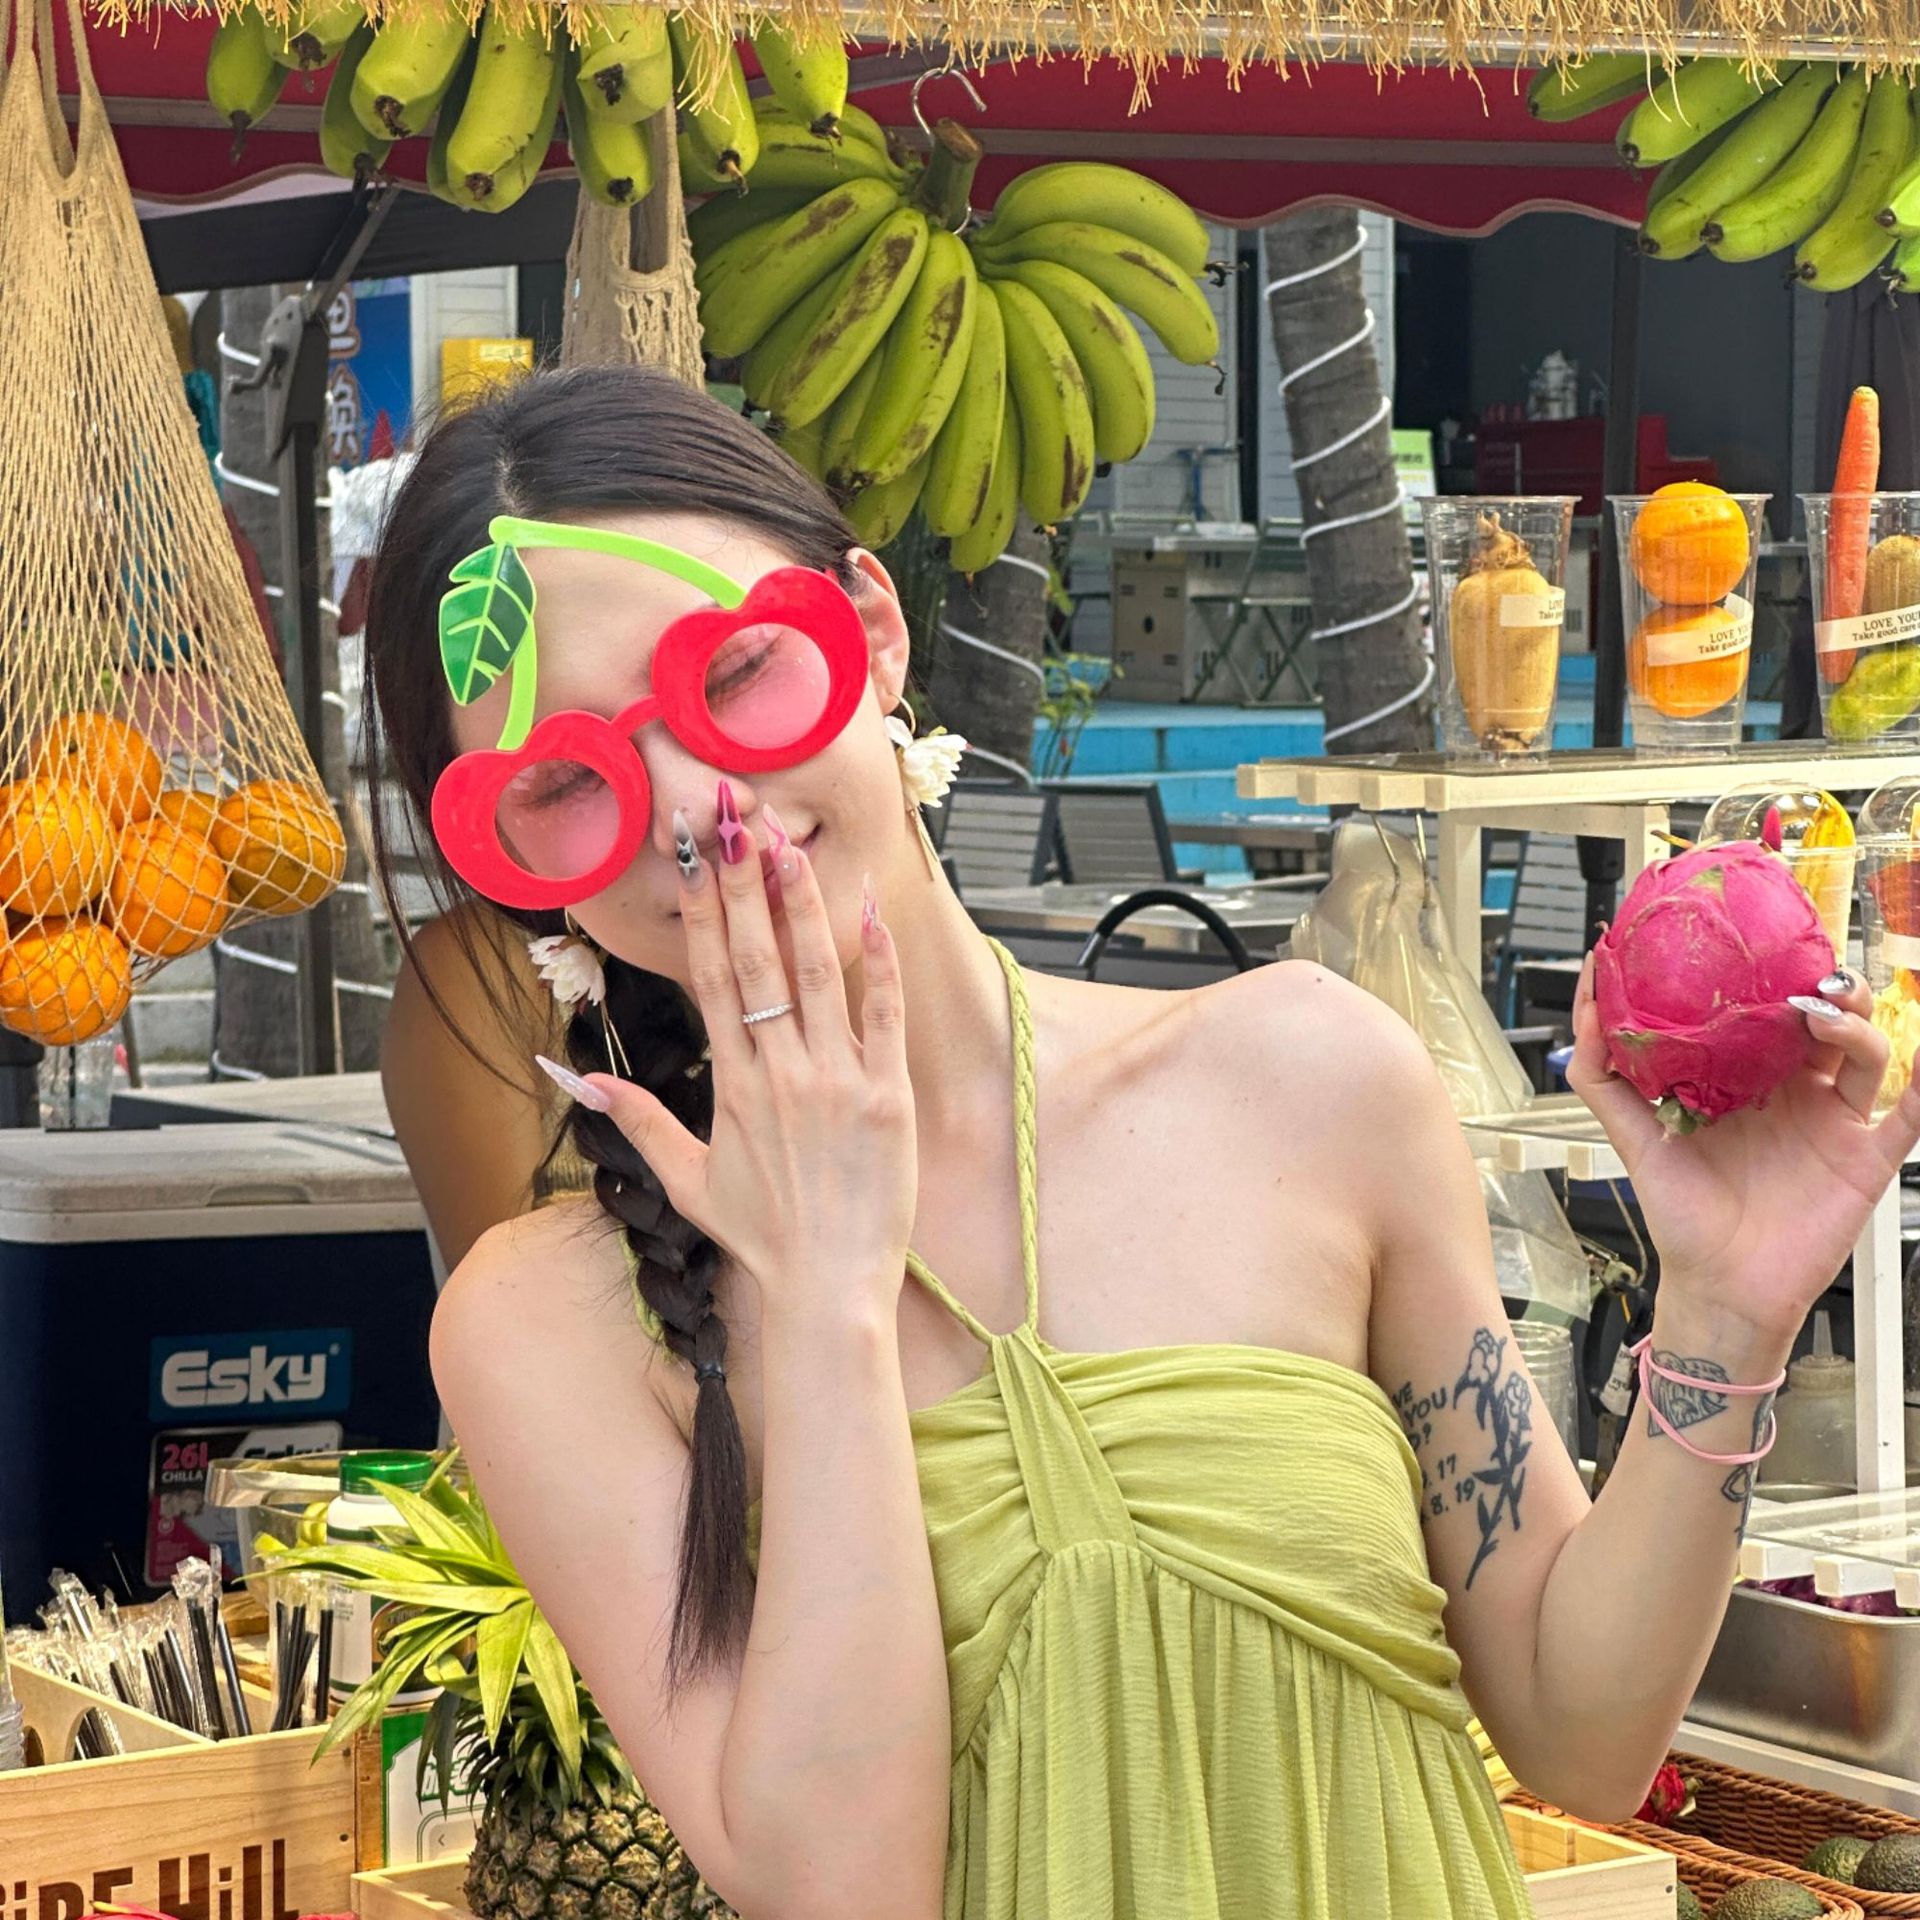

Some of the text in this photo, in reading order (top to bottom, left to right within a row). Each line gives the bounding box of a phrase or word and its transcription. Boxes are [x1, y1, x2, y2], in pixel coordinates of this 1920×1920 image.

[1863, 610, 1920, 631] LOVE YOU
[1710, 629, 1735, 644] LOVE
[1852, 631, 1875, 642] Take
[1877, 626, 1898, 639] good
[1899, 623, 1917, 633] care
[1698, 644, 1720, 654] Take
[1721, 638, 1738, 650] good
[161, 1345, 328, 1408] Esky
[1404, 1387, 1447, 1428] YOU
[161, 1469, 204, 1483] CHILLA
[1438, 1453, 1456, 1479] 17
[1455, 1477, 1475, 1503] 19
